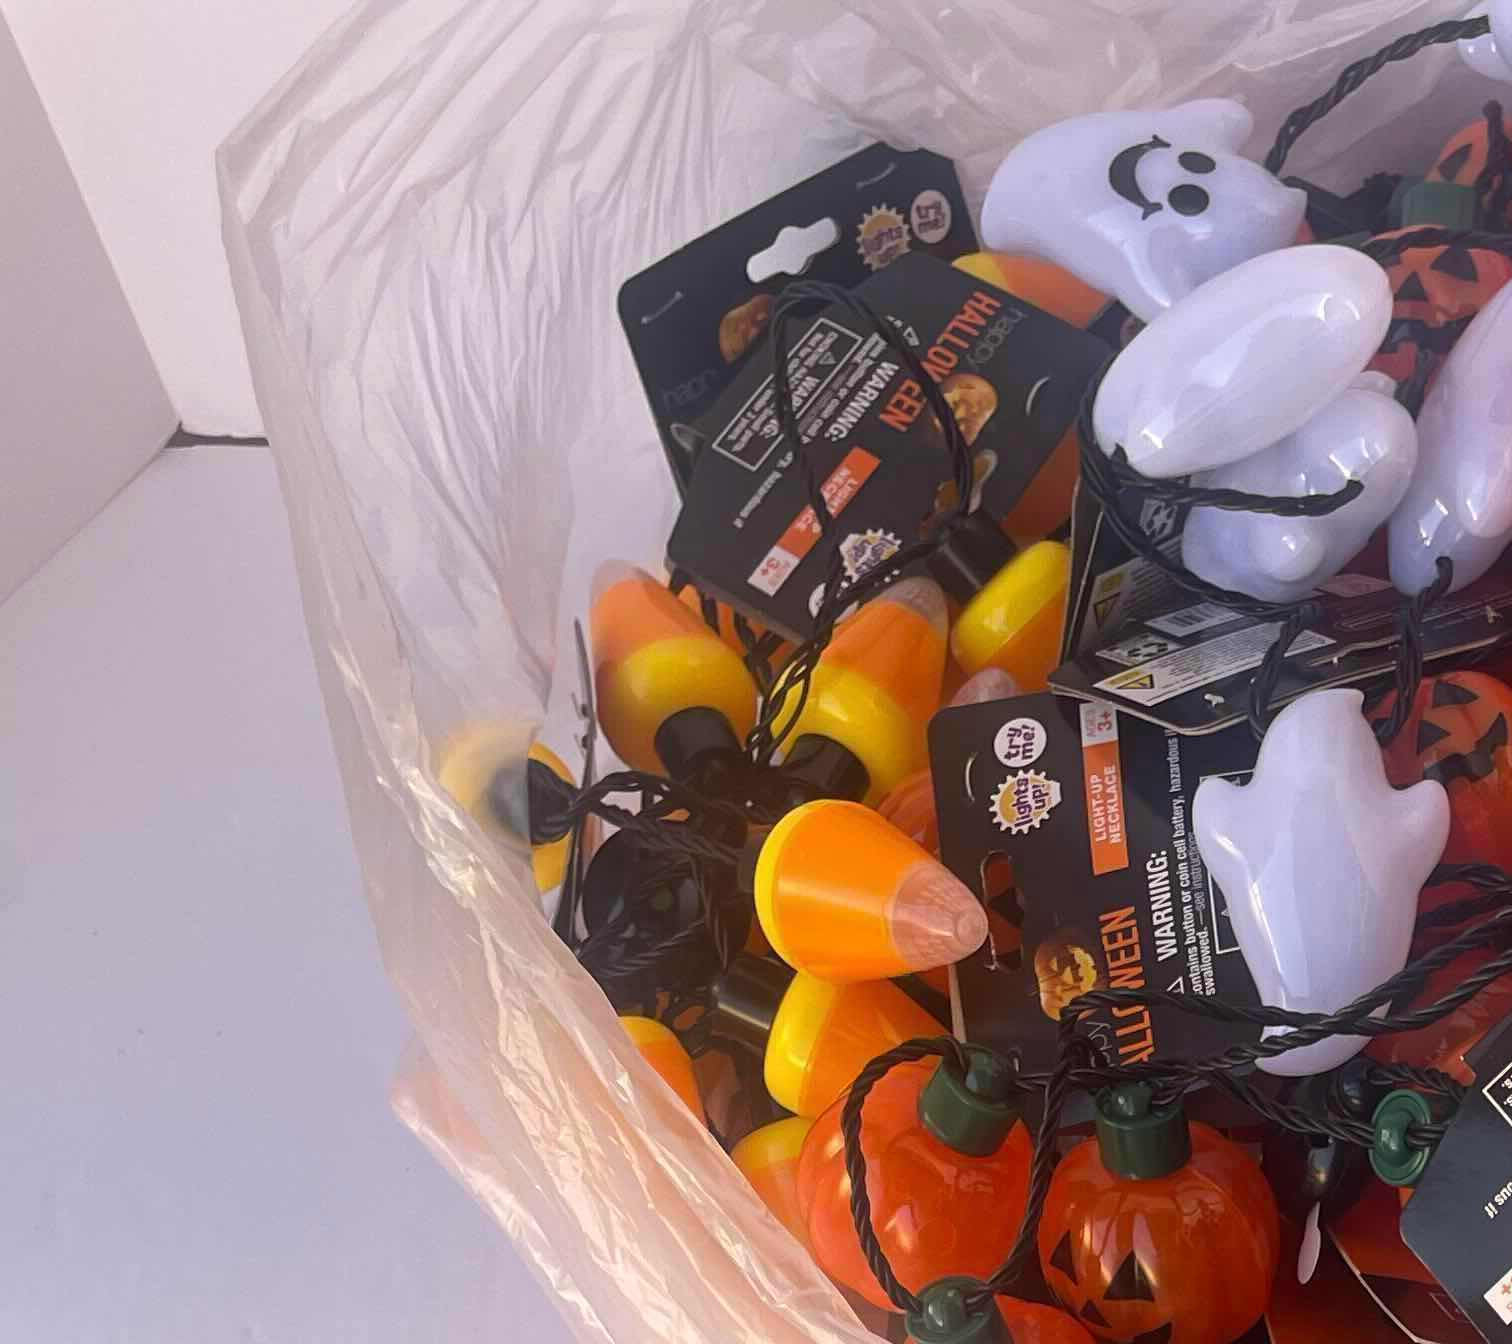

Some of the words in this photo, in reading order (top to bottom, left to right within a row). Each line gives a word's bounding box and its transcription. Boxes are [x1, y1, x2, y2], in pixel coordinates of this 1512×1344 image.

[824, 361, 899, 441] WARNING:
[1003, 727, 1027, 761] try
[1017, 724, 1036, 762] me!
[1011, 776, 1035, 830] lights
[1029, 784, 1051, 812] up!
[1089, 774, 1107, 842] LIGHT-UP
[1104, 763, 1122, 844] NECKLACE
[1175, 839, 1192, 863] cell
[1178, 862, 1197, 889] coin
[1181, 888, 1197, 904] or
[1147, 850, 1178, 961] WARNING:
[1182, 904, 1202, 946] button
[1197, 926, 1216, 996] swallowed.
